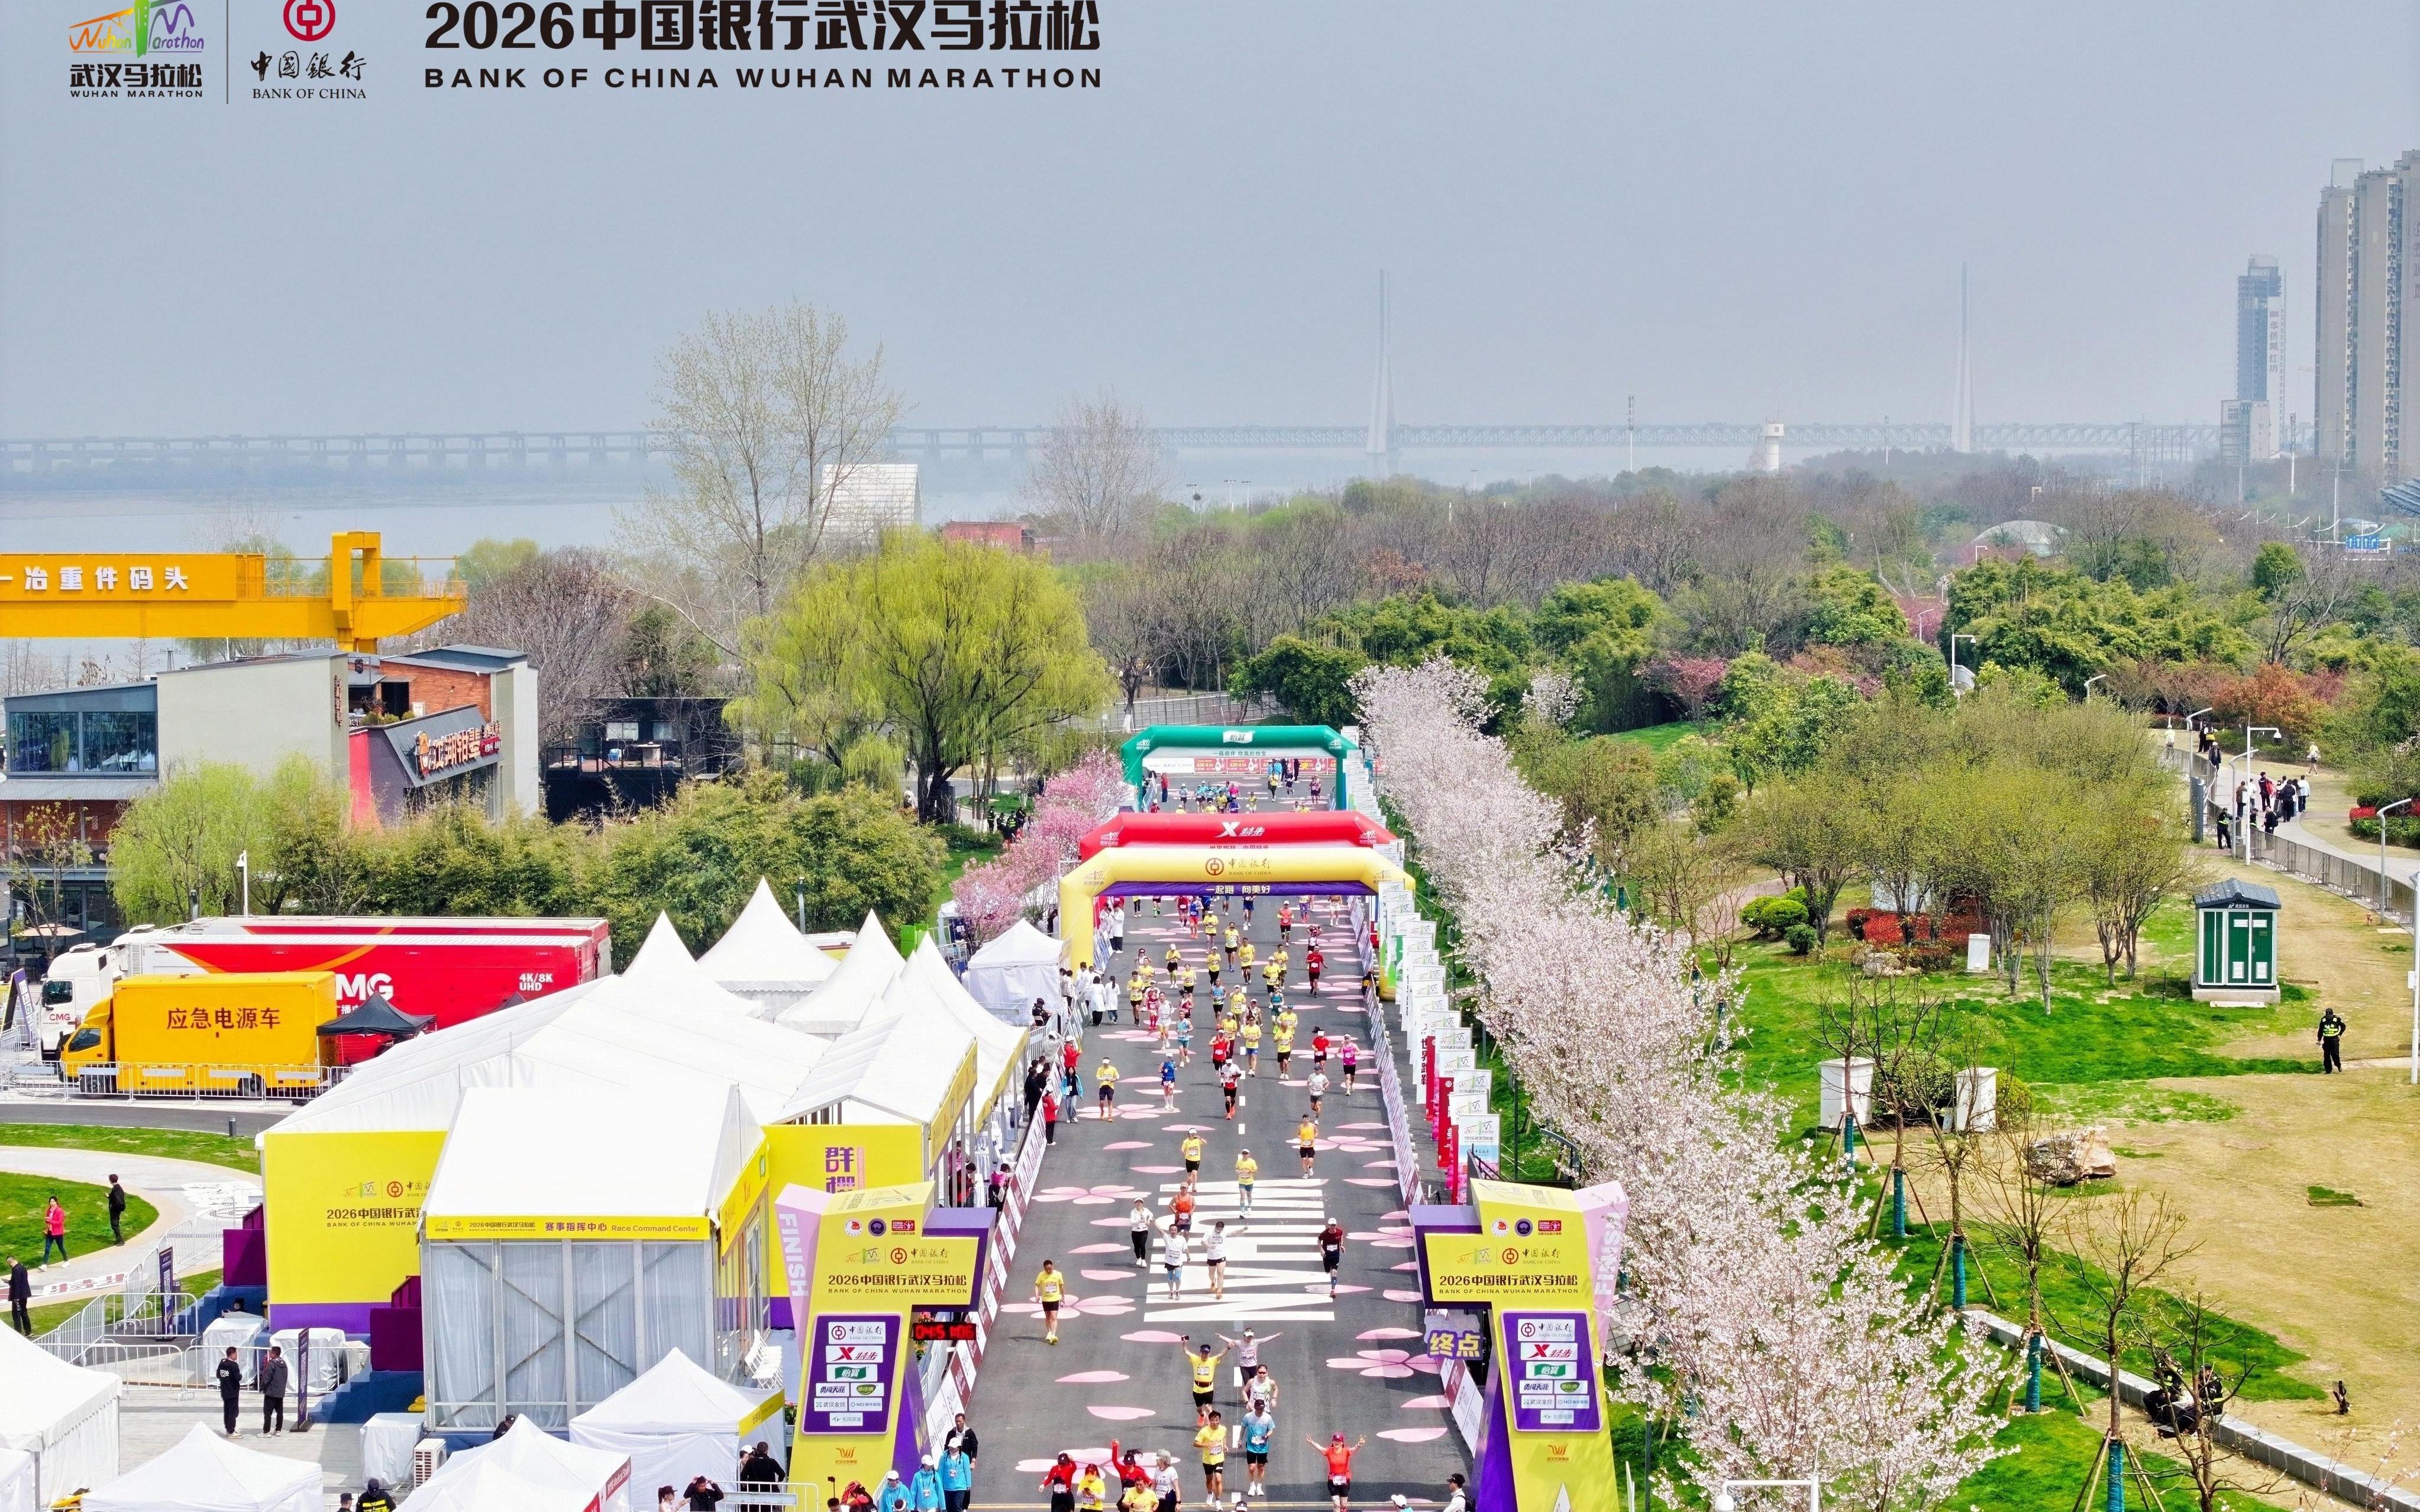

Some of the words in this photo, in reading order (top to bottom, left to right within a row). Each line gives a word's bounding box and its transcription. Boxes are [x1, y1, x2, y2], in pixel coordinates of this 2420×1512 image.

[1239, 827, 1265, 836] 特步
[1206, 885, 1235, 894] 一起跑
[1242, 885, 1271, 894] 向美好
[519, 973, 553, 983] 4K/8K
[335, 973, 394, 1001] MG
[519, 982, 542, 991] UHD
[167, 1007, 280, 1029] 应急电源车
[545, 1222, 607, 1232] 赛事指挥中心
[779, 1213, 809, 1296] FINISH
[828, 1275, 967, 1285] 2026中国银行武汉马拉松
[1439, 1275, 1578, 1285] 2026中国银行武汉马拉松
[1429, 1333, 1480, 1357] 终点
[1548, 1349, 1572, 1358] 特步
